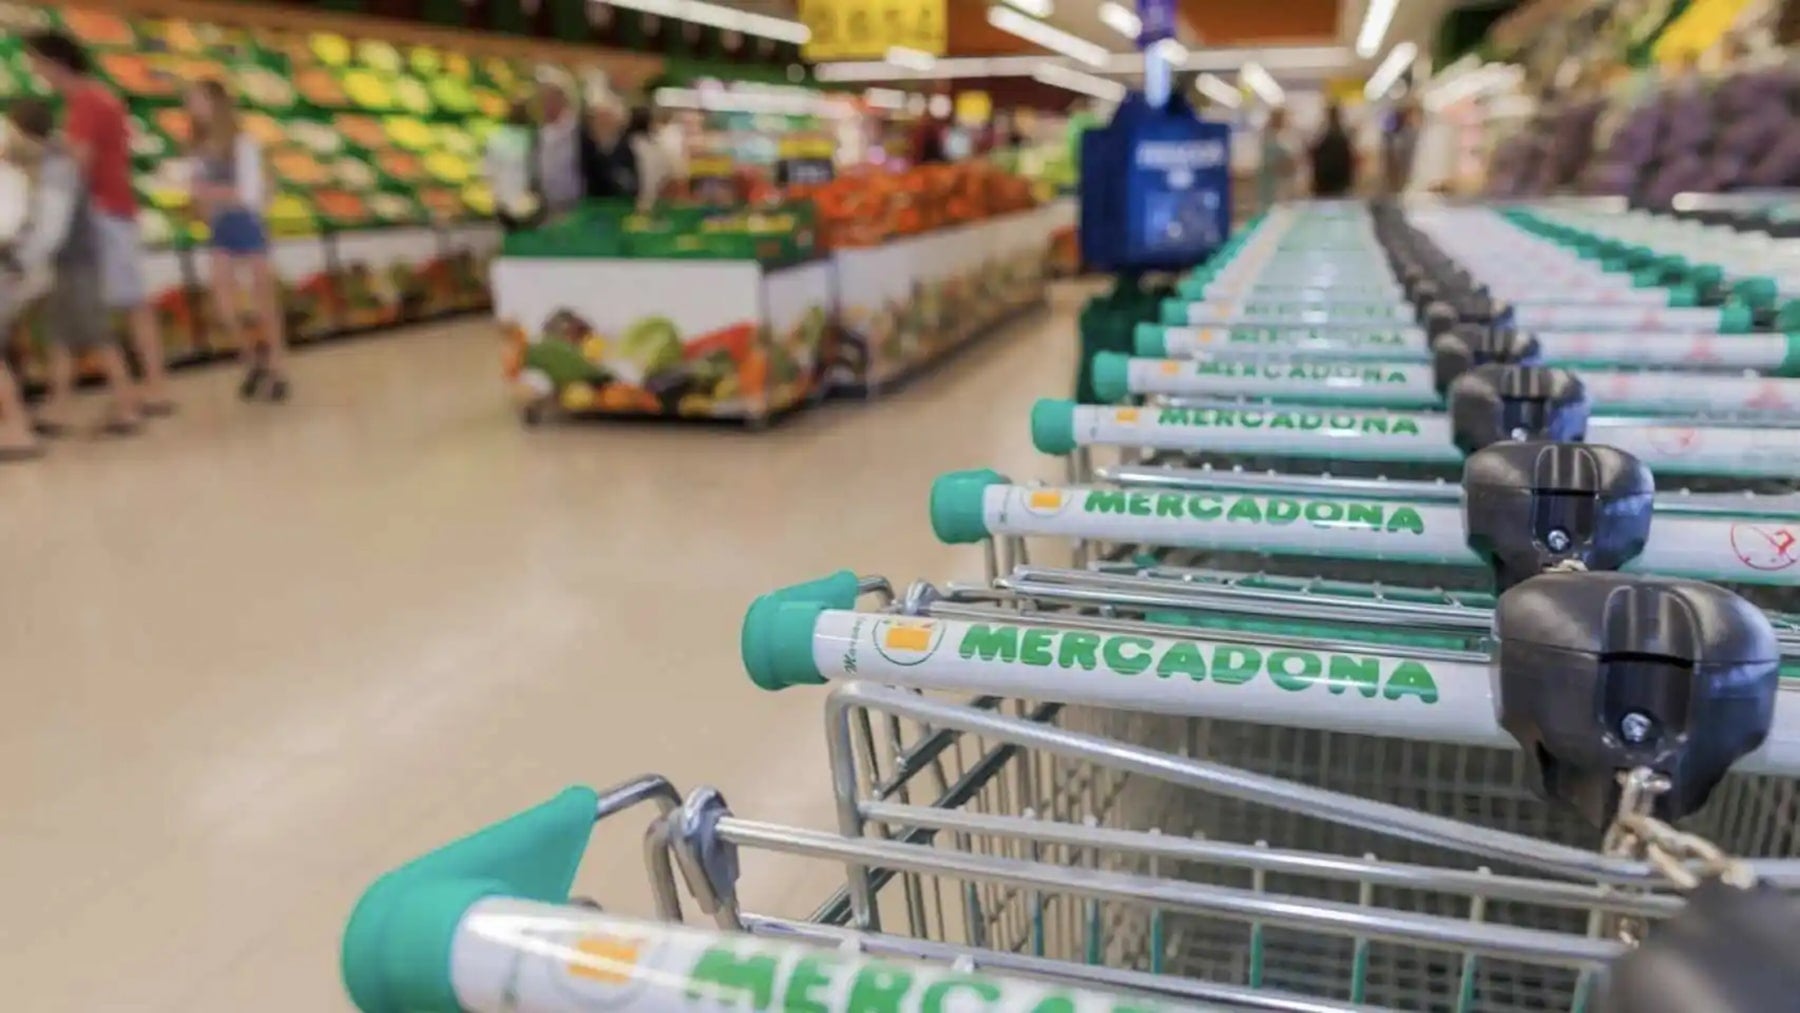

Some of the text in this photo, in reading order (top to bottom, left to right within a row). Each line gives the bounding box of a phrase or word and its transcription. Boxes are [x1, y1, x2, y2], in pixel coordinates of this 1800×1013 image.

[1157, 406, 1420, 436] MERCADONA
[1085, 488, 1425, 535] MERCADONA
[958, 622, 1440, 705] MERCADONA
